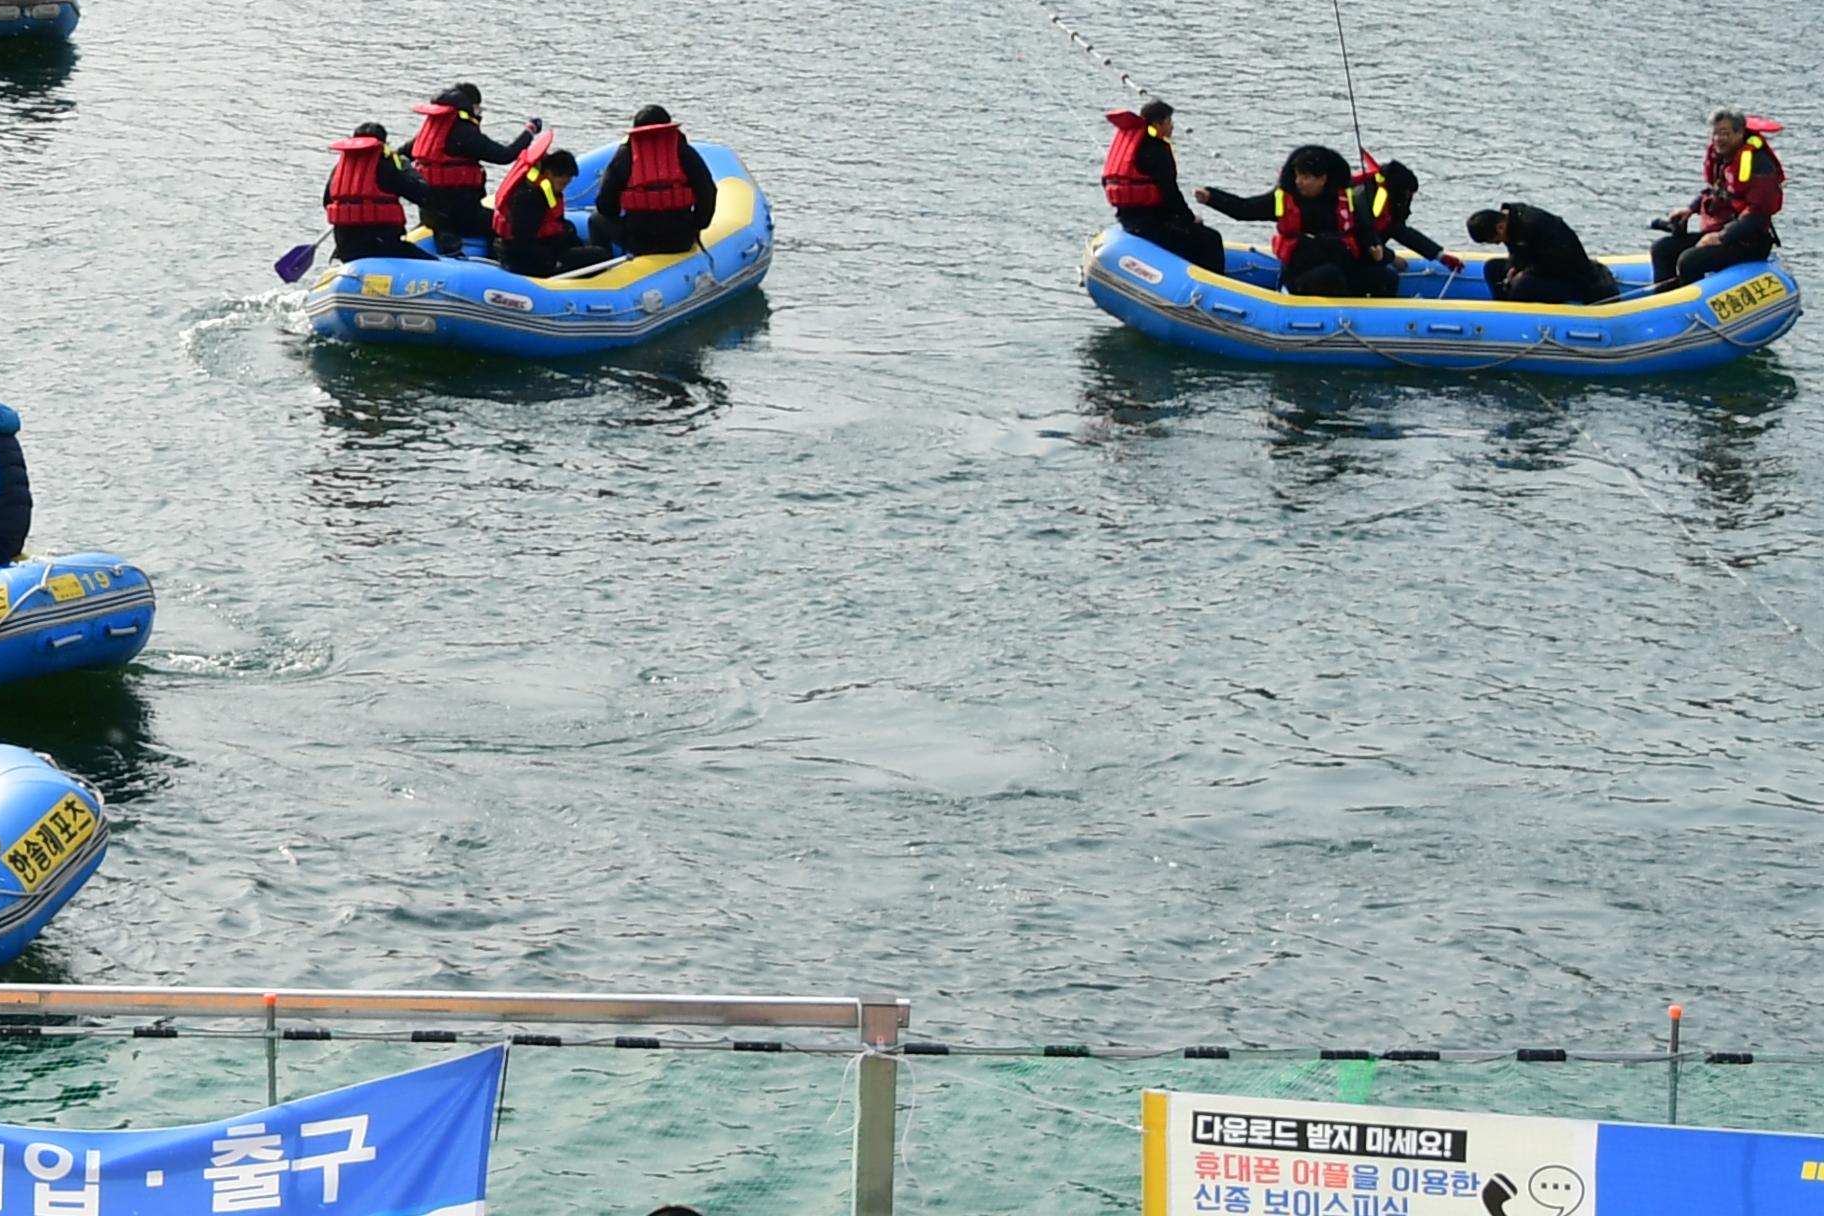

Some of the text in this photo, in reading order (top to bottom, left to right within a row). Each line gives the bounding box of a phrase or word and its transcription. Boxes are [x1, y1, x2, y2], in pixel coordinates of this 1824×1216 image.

[1709, 274, 1783, 321] 한솔레포츠
[81, 570, 112, 591] 19
[6, 795, 95, 887] 한솔레포츠
[1195, 1113, 1452, 1158] 다운로드 받지 마세요!
[202, 1112, 377, 1213] 출구
[1194, 1150, 1483, 1198] 휴대폰 어플을 이용한
[1193, 1183, 1251, 1214] 신종
